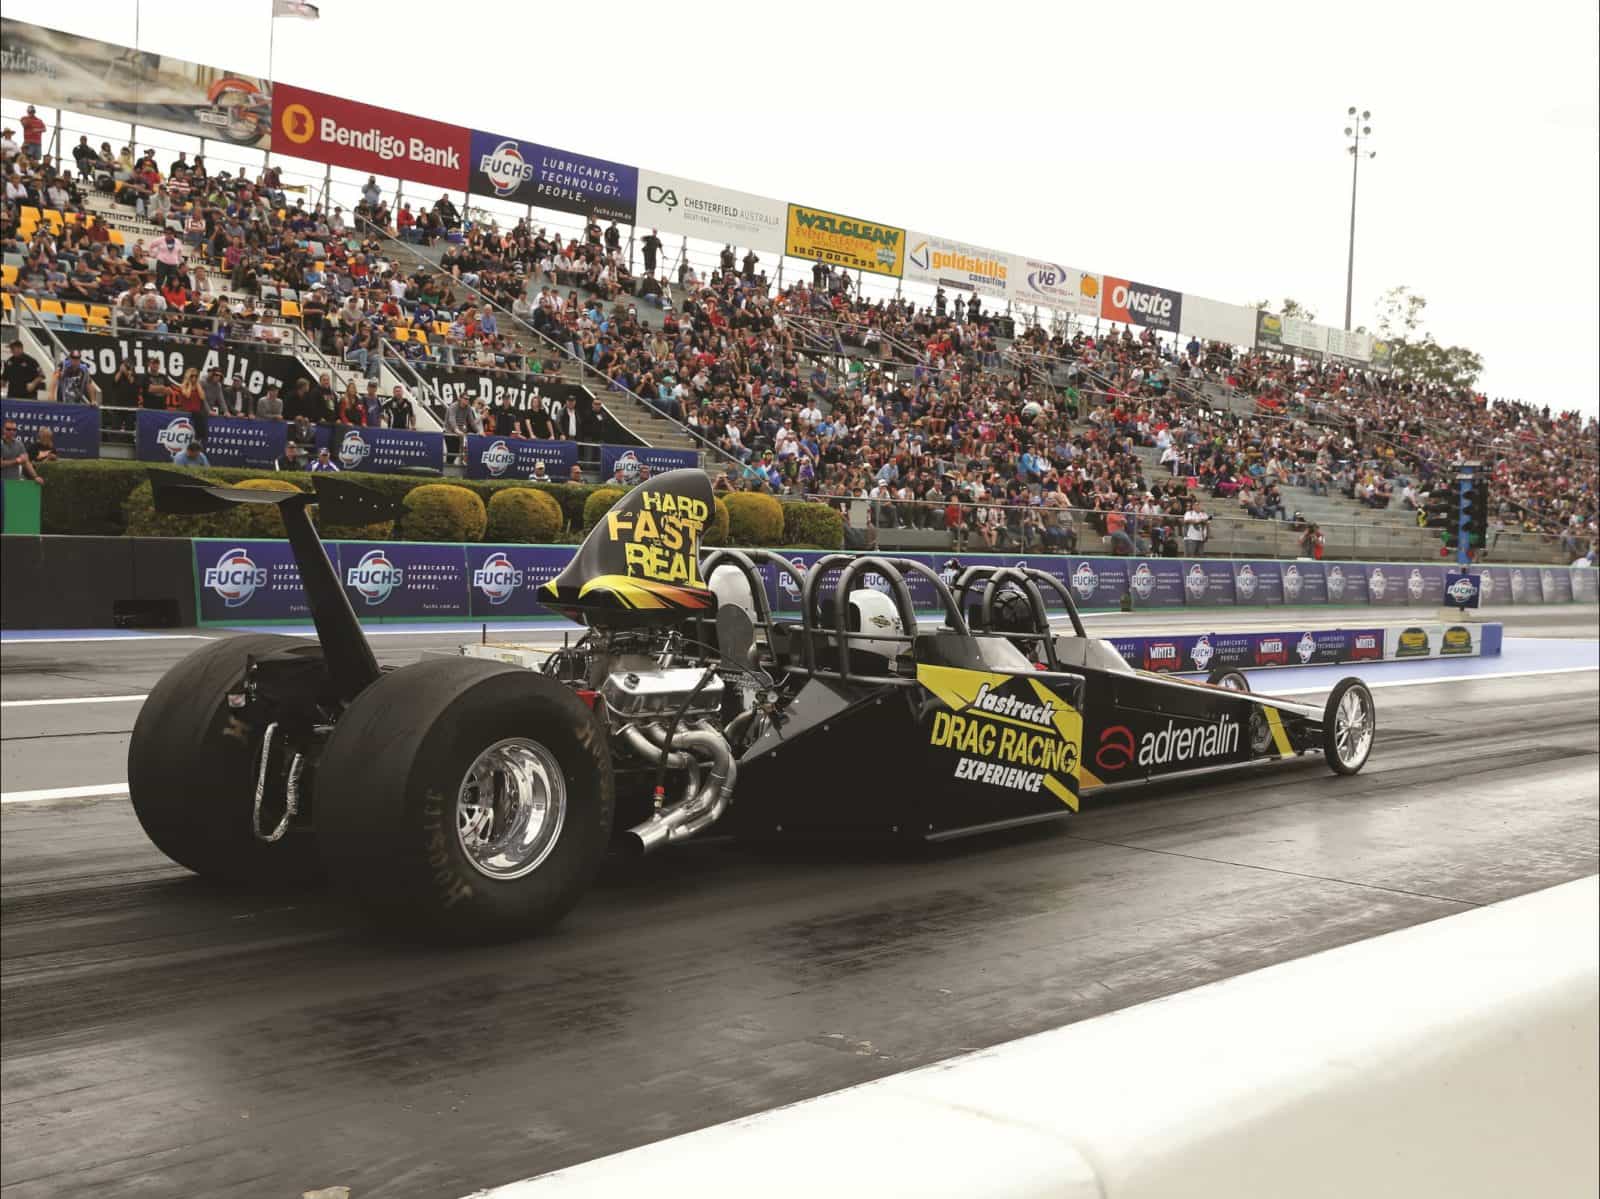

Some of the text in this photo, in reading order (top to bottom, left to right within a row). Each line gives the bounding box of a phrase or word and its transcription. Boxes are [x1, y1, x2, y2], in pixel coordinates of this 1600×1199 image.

[320, 117, 460, 170] Bendigo Bank
[482, 157, 533, 179] FUCHS
[543, 157, 619, 183] LUBRICANTS.
[537, 184, 586, 203] PEOPLE.
[541, 171, 621, 197] TECHNOLOGY.
[684, 198, 779, 225] CHESTERFIELD AUSTRALIA
[932, 249, 1007, 280] goldskills
[1039, 270, 1056, 286] WB
[61, 340, 184, 378] soline
[159, 431, 193, 443] FUCH
[342, 444, 370, 456] UCHS
[482, 452, 515, 464] FUCHS
[642, 491, 709, 522] HARD
[607, 509, 704, 555] FAST
[625, 542, 708, 590] REAL
[206, 569, 266, 586] FUCHS
[349, 569, 402, 586] FUCHS
[475, 571, 522, 585] FUCHS
[1073, 576, 1098, 586] FUCHS
[1132, 576, 1156, 586] FUCHS
[1448, 586, 1477, 595] FUCHS
[1150, 646, 1176, 660] WINTER
[1260, 641, 1282, 653] WINTER
[974, 684, 1056, 725] fastrack
[930, 711, 1078, 774] DRAG RACING
[1138, 714, 1240, 766] adrenalin
[954, 757, 1044, 793] EXPERIENCE
